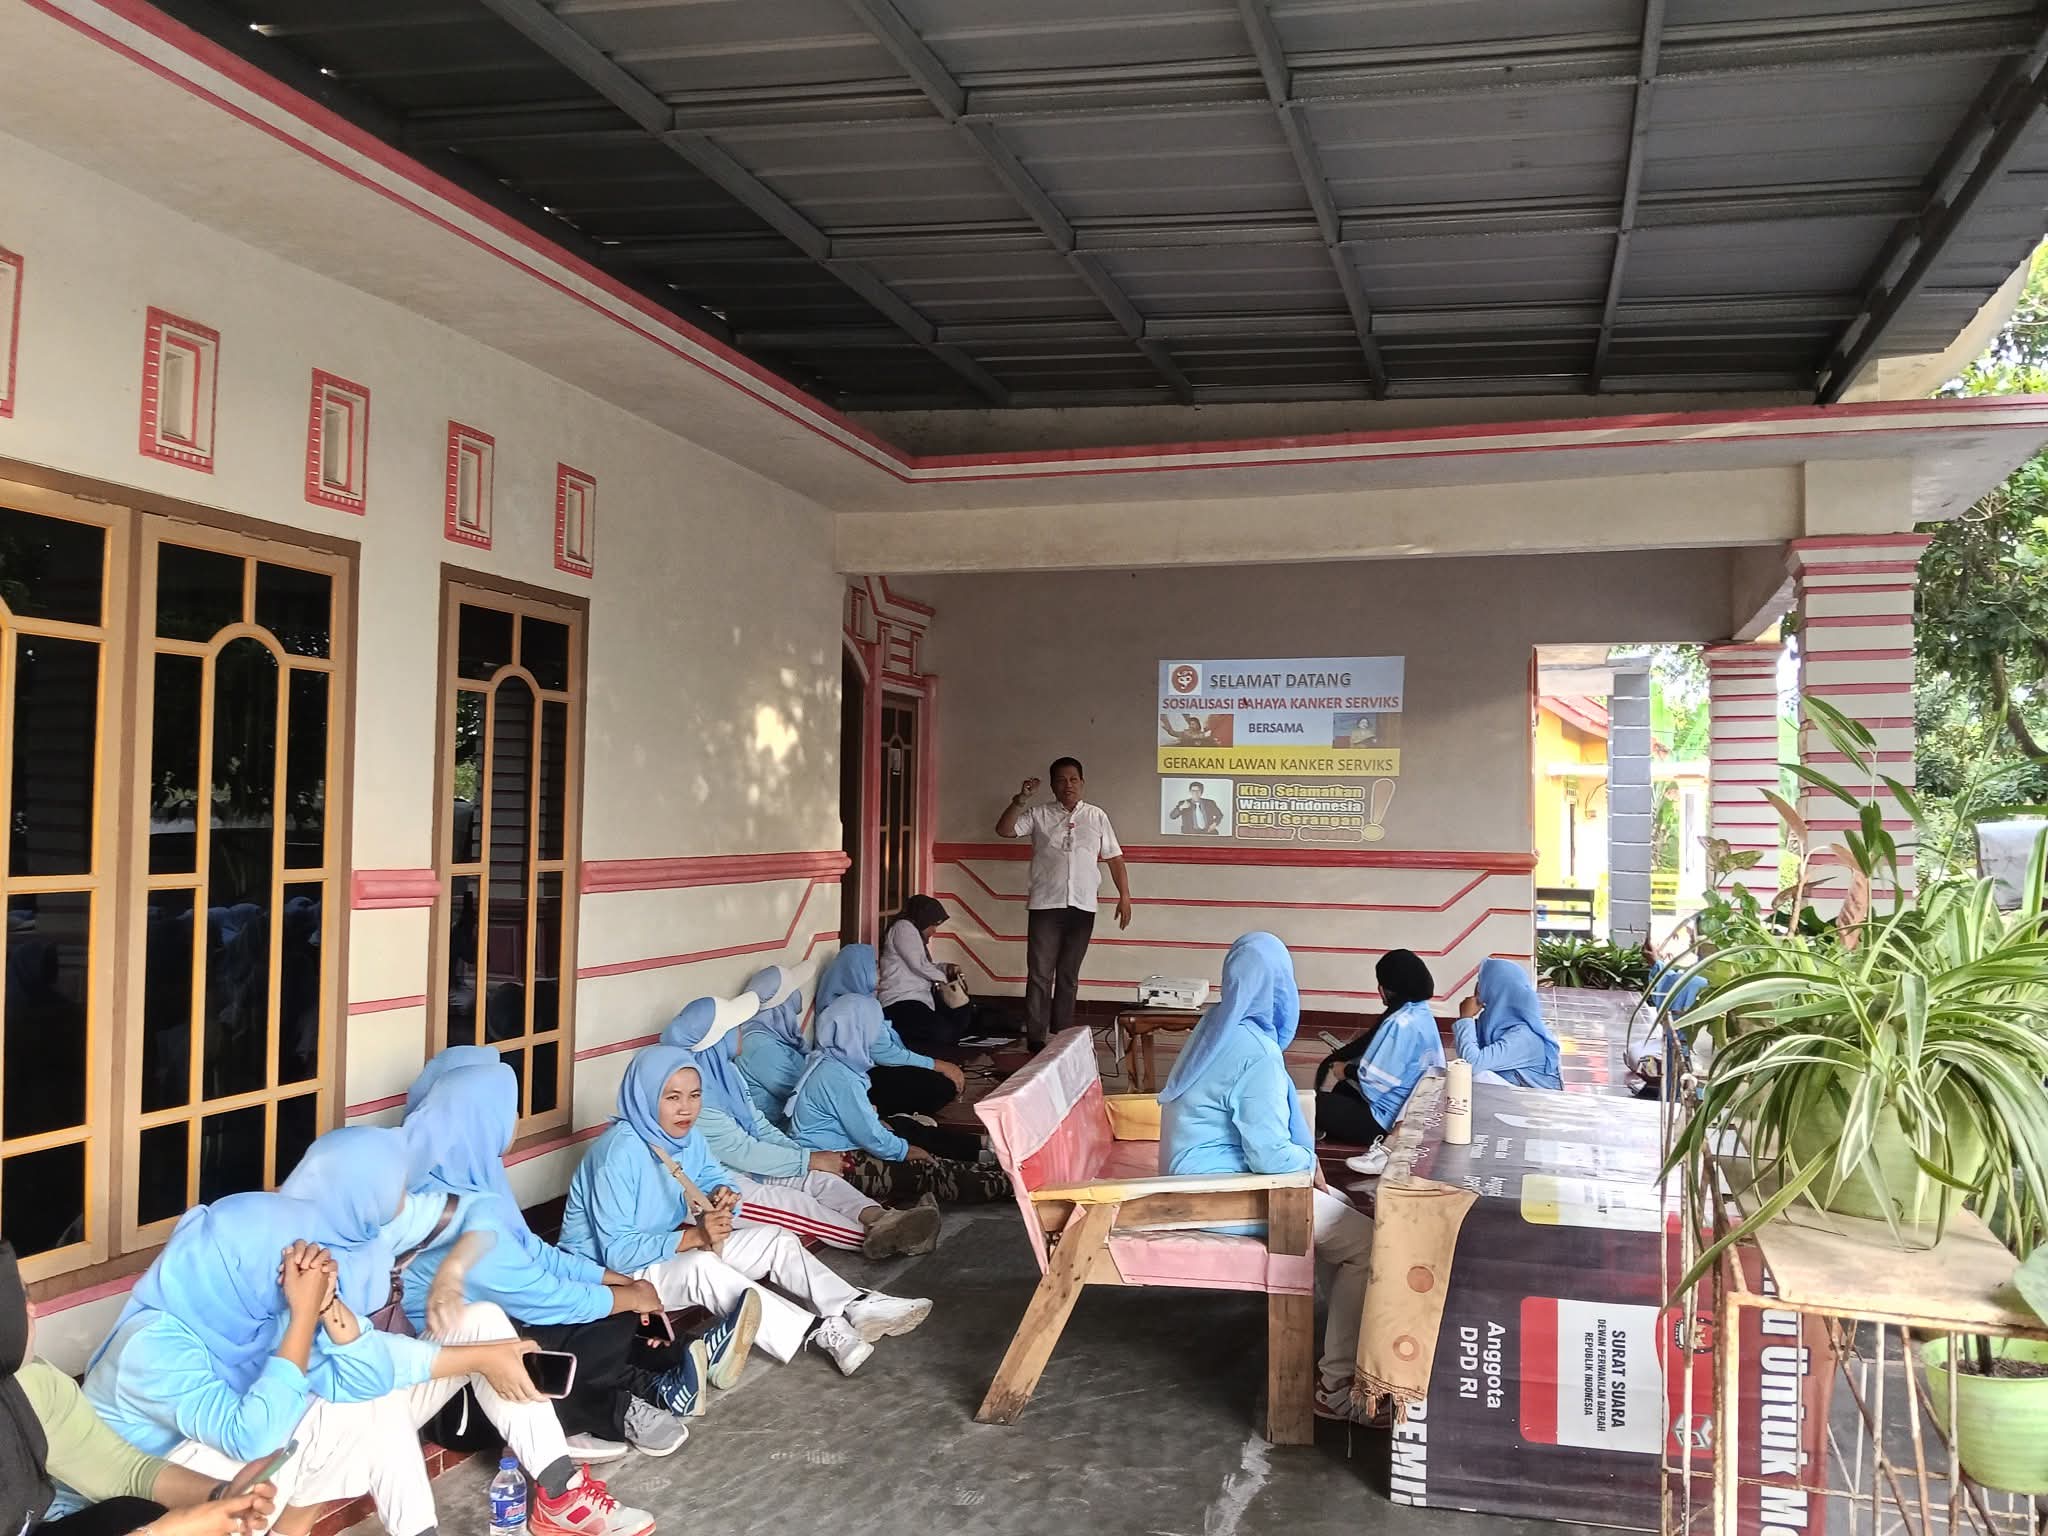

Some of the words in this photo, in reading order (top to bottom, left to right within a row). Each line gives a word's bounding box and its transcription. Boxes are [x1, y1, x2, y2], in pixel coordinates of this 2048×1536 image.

[1209, 674, 1281, 689] SELAMAT
[1286, 672, 1352, 688] DATANG
[1162, 697, 1234, 710] SOSIALISASI
[1237, 697, 1287, 710] BAHAYA
[1291, 697, 1342, 709] KANKER
[1345, 696, 1400, 709] SERVIKS
[1248, 723, 1304, 734] BERSAMA
[1163, 757, 1225, 770] GERAKAN
[1229, 758, 1277, 771] LAWAN
[1280, 758, 1334, 771] KANKER
[1338, 759, 1393, 772] SERVIKS
[1239, 784, 1269, 797] Kita
[1275, 784, 1363, 798] Selamatkan
[1239, 798, 1287, 811] Wanita
[1290, 799, 1363, 812] Indonesia
[1239, 812, 1273, 824] Dari
[1280, 813, 1362, 826] Serangan
[1597, 1319, 1606, 1347] DEWAN
[1459, 1326, 1479, 1370] DPD
[1584, 1332, 1593, 1371] REPUBLIK
[1611, 1330, 1626, 1377] SURAT
[1484, 1320, 1506, 1409] Anggota
[1597, 1348, 1606, 1399] PERWAKILAN
[1459, 1377, 1479, 1398] RI
[1584, 1373, 1593, 1416] INDONESIA
[1597, 1401, 1606, 1432] DAERAH
[1611, 1381, 1626, 1428] SUARA
[1760, 1345, 1809, 1476] Untuk
